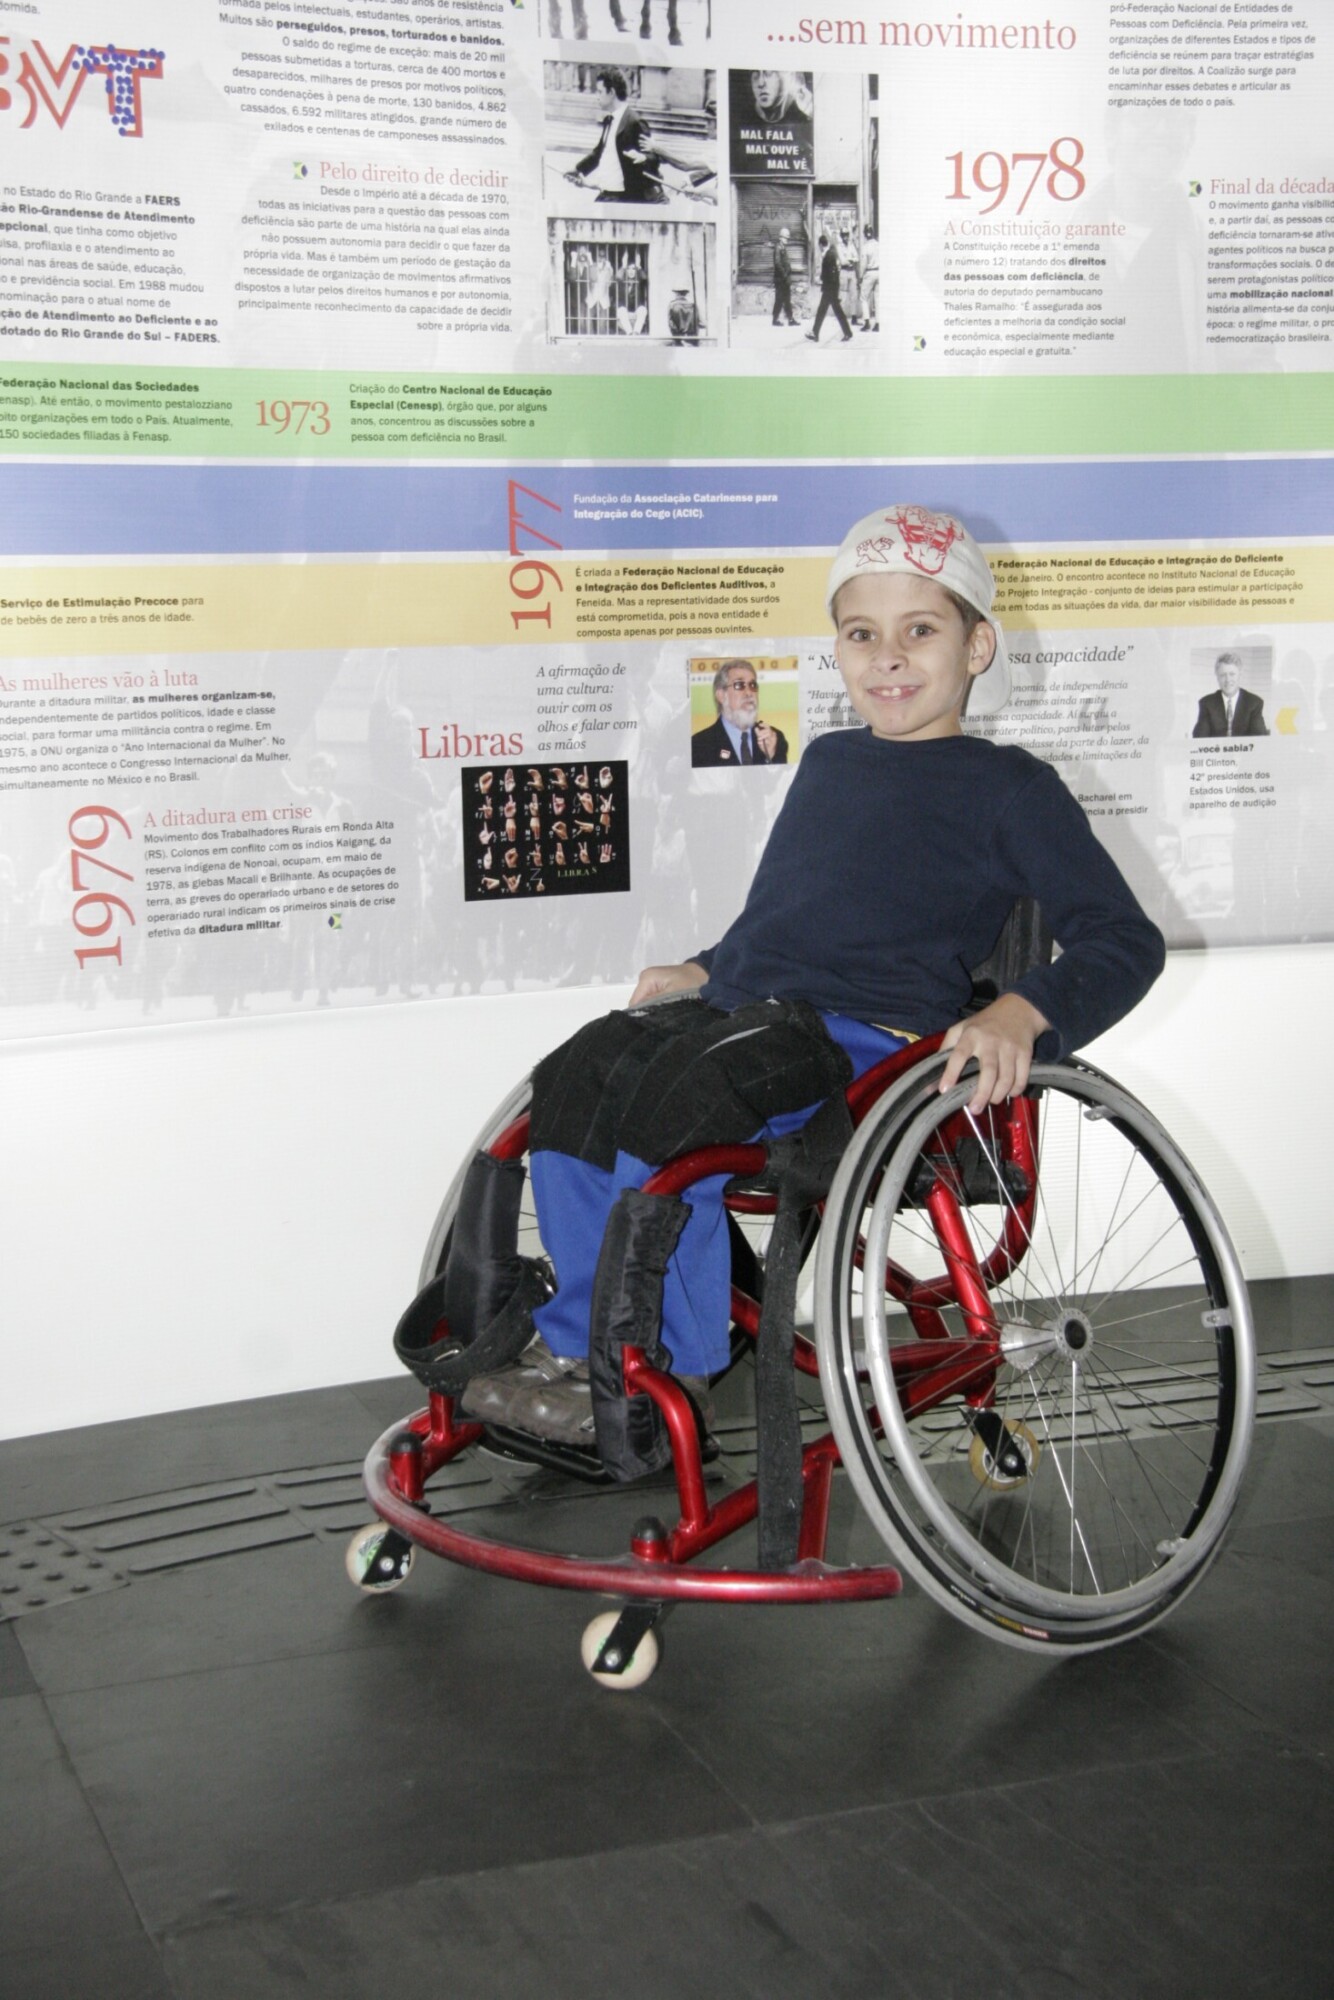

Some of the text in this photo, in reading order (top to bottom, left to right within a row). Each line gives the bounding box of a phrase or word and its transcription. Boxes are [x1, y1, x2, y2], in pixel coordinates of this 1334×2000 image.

[219, 12, 253, 25] Muitos
[255, 17, 273, 27] são
[276, 20, 346, 34] perseguidos,
[349, 27, 389, 38] presos,
[391, 28, 448, 42] torturados
[460, 33, 504, 46] banidos.
[1109, 18, 1147, 28] Pessoas
[1172, 19, 1224, 29] Deficiência.
[1227, 19, 1248, 29] Pela
[1250, 19, 1288, 30] primeira
[879, 13, 1077, 50] movimento
[740, 129, 793, 141] MAL FALA
[745, 144, 799, 155] MAL OUVE
[767, 158, 808, 171] MAL VÊ
[319, 161, 509, 188] Pelo direito de decidir
[945, 137, 1086, 216] 1978
[1210, 178, 1252, 195] Final
[1256, 178, 1275, 195] da
[18, 203, 195, 224] Rio-Grandense de Atendimento
[960, 220, 1062, 239] Constituição
[1065, 223, 1127, 240] garante
[944, 272, 962, 281] das
[964, 274, 1004, 282] pessoas
[1030, 272, 1085, 281] deficiência,
[1088, 272, 1100, 281] de
[1229, 289, 1289, 300] mobilização
[44, 327, 58, 337] do
[61, 328, 80, 338] Rio
[83, 329, 124, 340] Grande
[127, 331, 141, 340] do
[143, 331, 161, 341] Sul
[174, 332, 220, 343] FADERS.
[1206, 333, 1286, 344] redemocratização
[59, 379, 109, 390] Nacional
[112, 380, 132, 390] das
[135, 381, 200, 392] Sociedades
[349, 384, 552, 398] Criação do Centro Nacional de Educação
[255, 399, 331, 435] 1973
[573, 493, 778, 505] Fundação da Associação Catarinense para
[574, 508, 628, 520] Integração
[630, 509, 644, 518] do
[645, 508, 671, 520] Cego
[508, 479, 563, 630] 1977
[997, 559, 1048, 569] Federação
[1050, 558, 1092, 567] Nacional
[1094, 558, 1107, 566] de
[1109, 557, 1156, 567] Educação
[1166, 555, 1218, 566] Integração
[1220, 555, 1232, 564] do
[1234, 554, 1284, 563] Deficiente
[583, 568, 612, 577] criada
[622, 566, 674, 577] Federação
[676, 566, 720, 575] Nacional
[722, 565, 735, 574] de
[737, 564, 784, 575] Educação
[0, 596, 204, 609] Serviço de Estimulação Precoce para
[548, 664, 610, 680] afirmação
[612, 662, 626, 675] de
[21, 671, 108, 692] mulheres
[112, 670, 145, 688] vão
[164, 669, 200, 688] luta
[537, 682, 614, 696] uma cultura:
[148, 693, 199, 703] mulheres
[201, 690, 276, 703] organizam-se,
[536, 701, 612, 714] ouvir com os
[537, 720, 568, 733] olhos
[579, 718, 610, 734] falar
[612, 720, 637, 730] com
[418, 724, 524, 759] Libras
[537, 738, 586, 751] as mãos
[1222, 743, 1254, 753] sabia?
[1190, 758, 1204, 768] Bill
[1207, 772, 1253, 782] presidente
[1254, 771, 1270, 779] dos
[1189, 785, 1275, 796] Estados Unidos, usa
[1189, 798, 1276, 810] aparelho de audição
[161, 808, 237, 828] ditadura
[242, 810, 267, 823] em
[272, 804, 312, 819] crise
[144, 820, 394, 843] Movimento dos Trabalhadores Rurais em Ronda Alta
[68, 805, 136, 970] 1979
[148, 929, 180, 938] efetiva
[183, 927, 196, 935] da
[198, 923, 244, 934] ditadura
